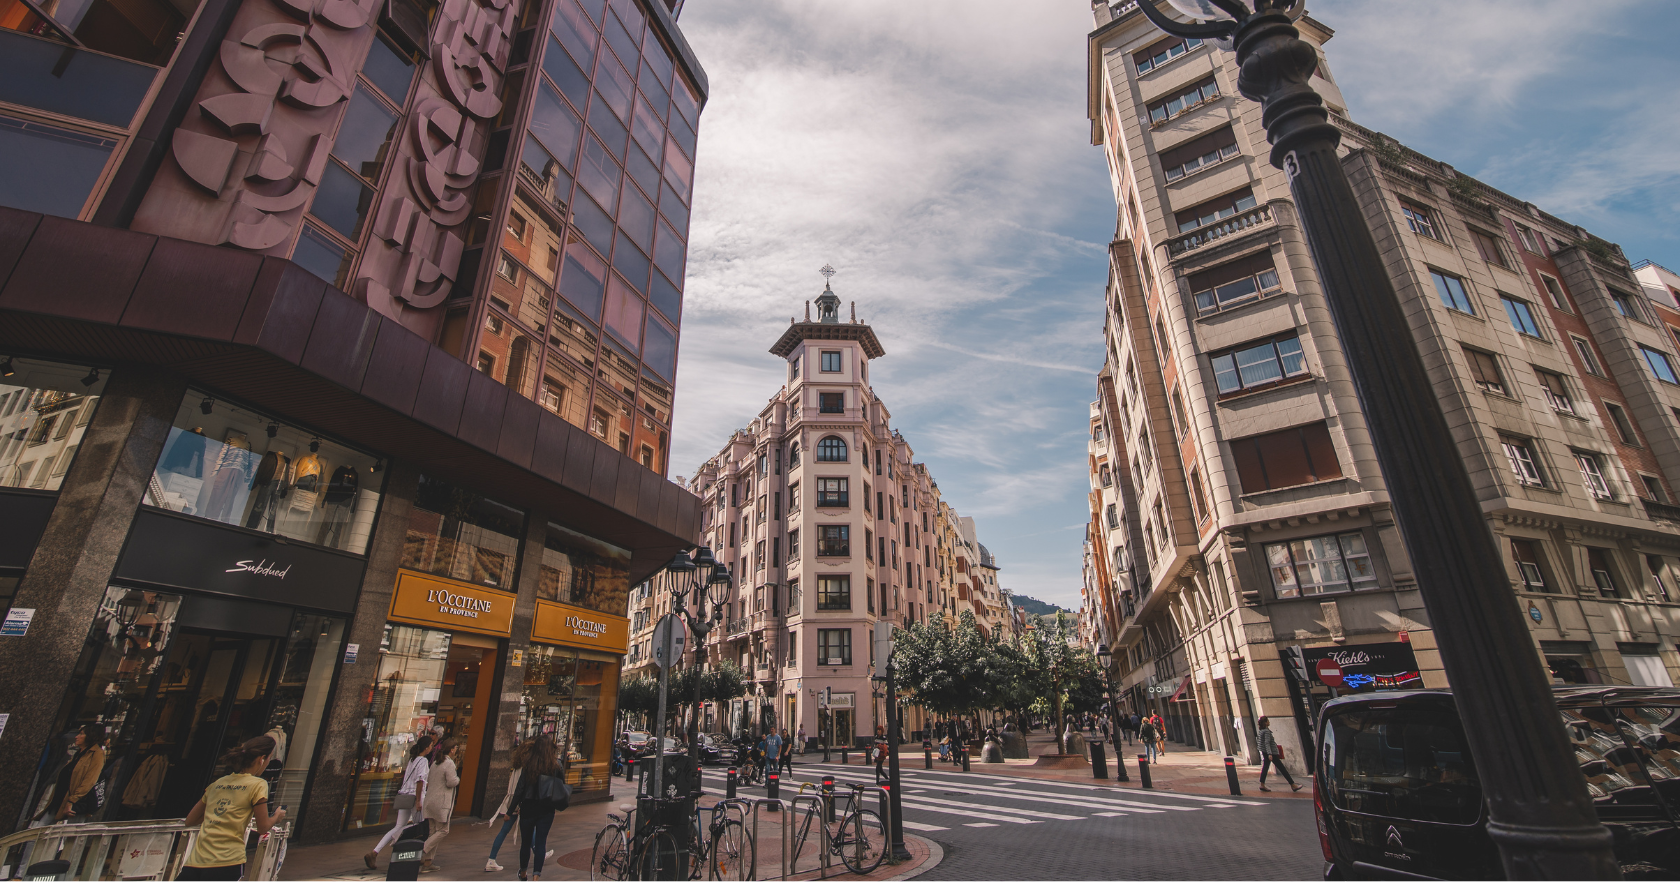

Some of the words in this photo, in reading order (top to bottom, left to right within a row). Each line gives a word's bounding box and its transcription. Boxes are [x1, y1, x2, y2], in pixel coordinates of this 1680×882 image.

[225, 558, 292, 580] Subdued
[427, 589, 492, 613] L'OCCITANE
[439, 605, 449, 613] EN
[449, 607, 478, 619] PROVENCE
[565, 615, 607, 634] L'OCCITANE
[1327, 650, 1370, 666] Kiehl's
